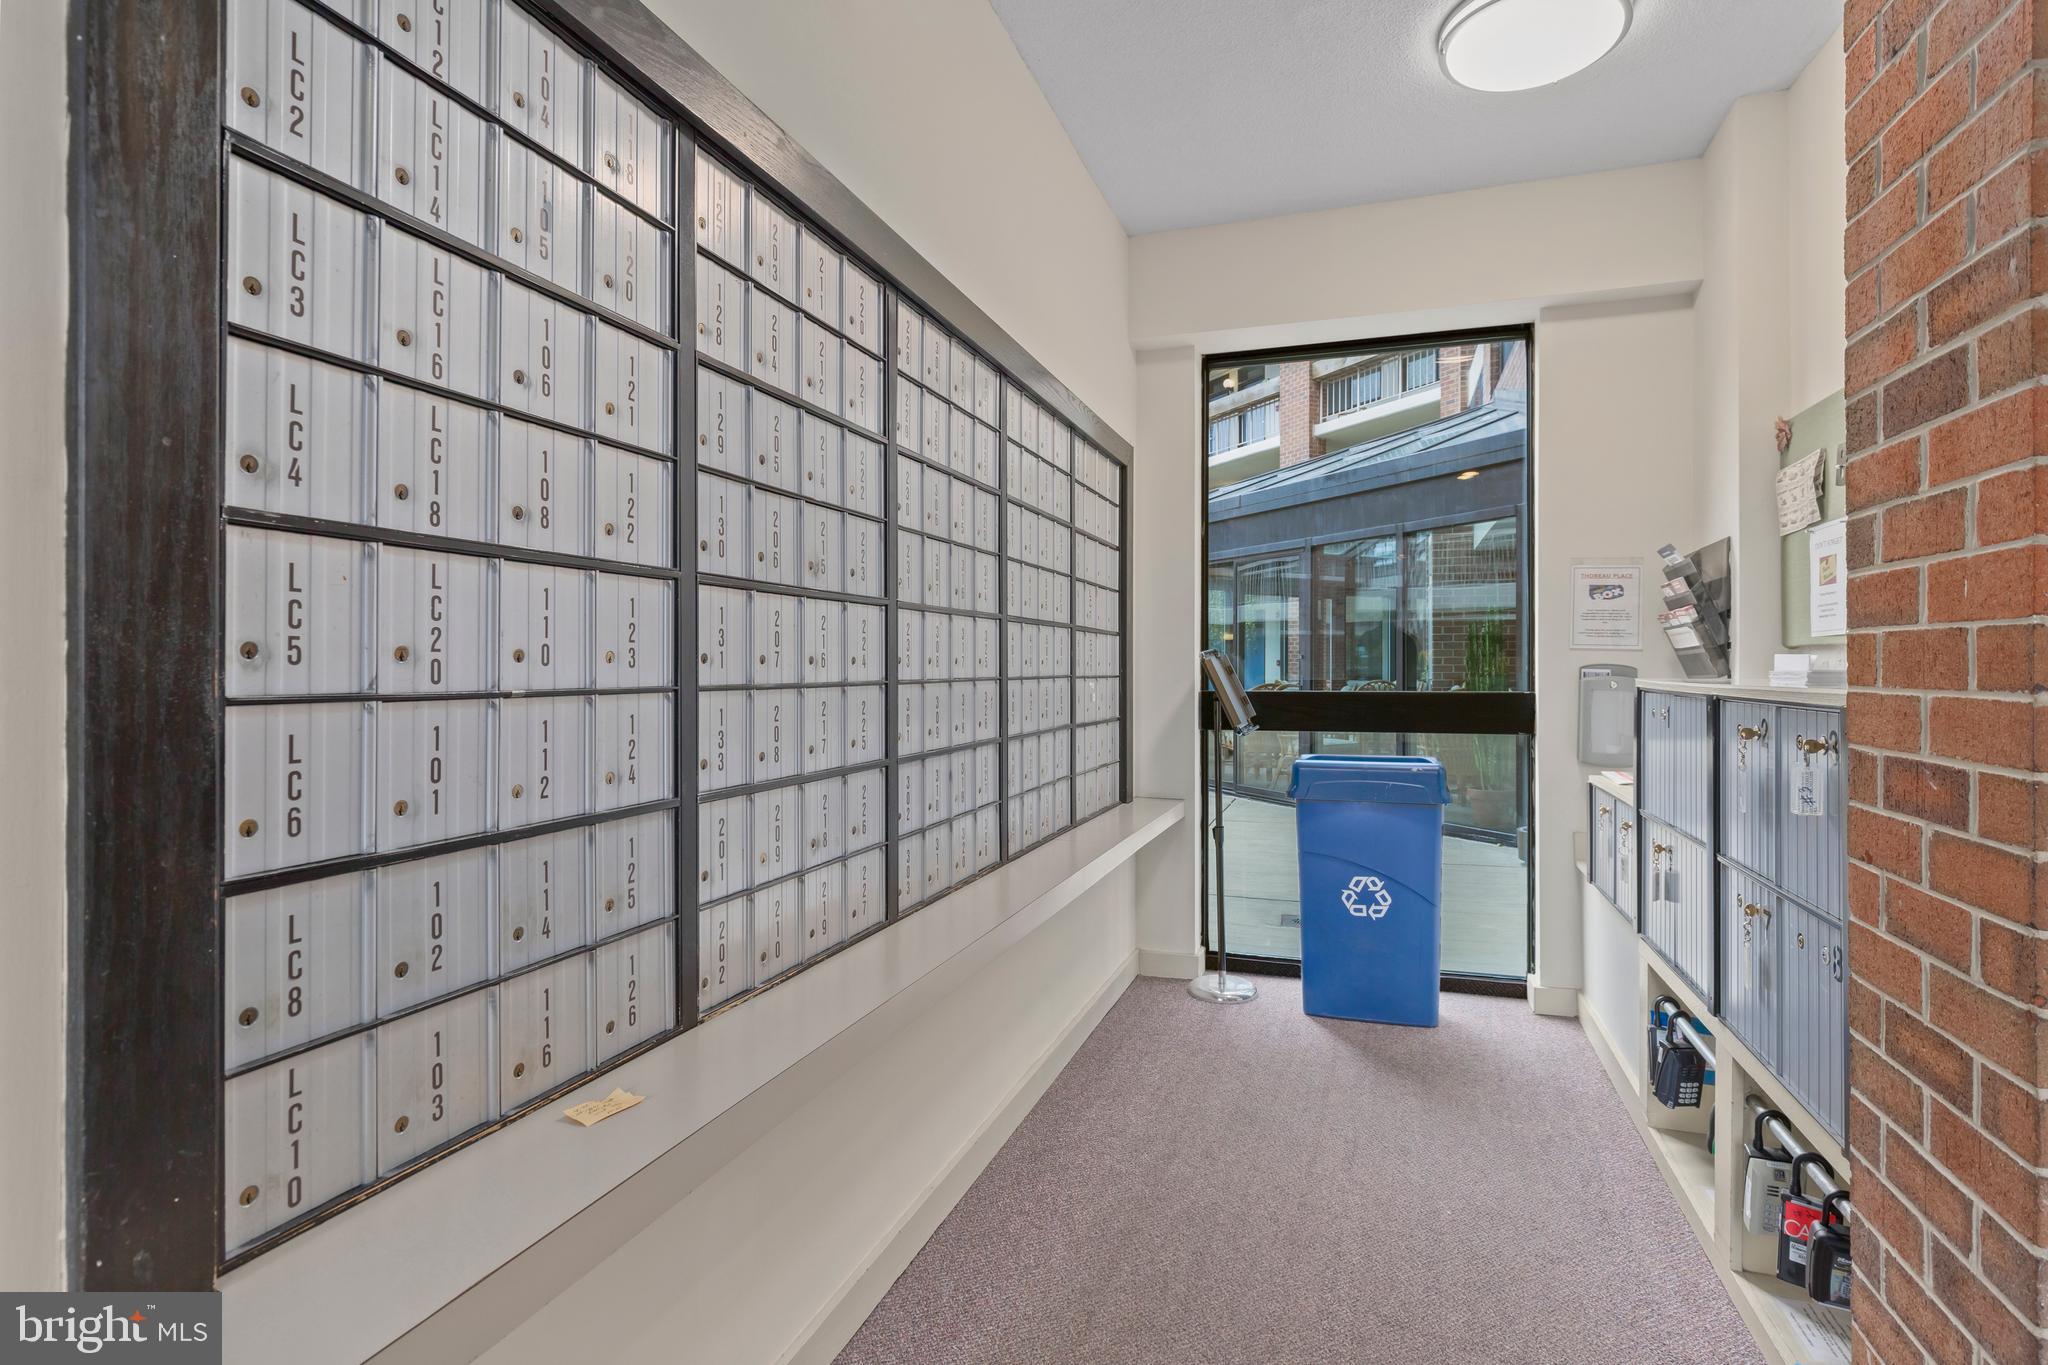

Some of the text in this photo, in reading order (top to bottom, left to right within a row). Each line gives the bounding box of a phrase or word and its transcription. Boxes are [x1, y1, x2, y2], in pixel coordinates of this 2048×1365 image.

[289, 31, 306, 138] LC2
[540, 49, 549, 129] 104
[429, 100, 443, 224] LC14
[539, 180, 549, 261] 105
[289, 212, 307, 318] LC3
[625, 230, 634, 302] 120
[432, 257, 445, 380] LC16
[715, 283, 723, 346] 128
[541, 317, 551, 398] 106
[628, 355, 636, 425] 121
[287, 382, 304, 488] LC4
[428, 404, 443, 529] LC18
[540, 450, 549, 530] 108
[626, 472, 635, 545] 122
[287, 561, 303, 666] LC5
[429, 563, 443, 686] LC20
[541, 587, 550, 668] 110
[627, 597, 636, 669] 123
[429, 725, 443, 816] 101
[539, 719, 549, 800] 112
[627, 714, 636, 785] 124
[717, 708, 725, 771] 133
[287, 733, 303, 838] LC6
[627, 836, 636, 910] 125
[718, 818, 726, 881] 201
[430, 881, 443, 972] 102
[541, 860, 552, 940] 114
[287, 914, 304, 1018] LC8
[628, 954, 636, 1027] 126
[718, 921, 726, 985] 202
[541, 988, 552, 1069] 116
[431, 1031, 444, 1122] 103
[287, 1067, 304, 1209] LC10
